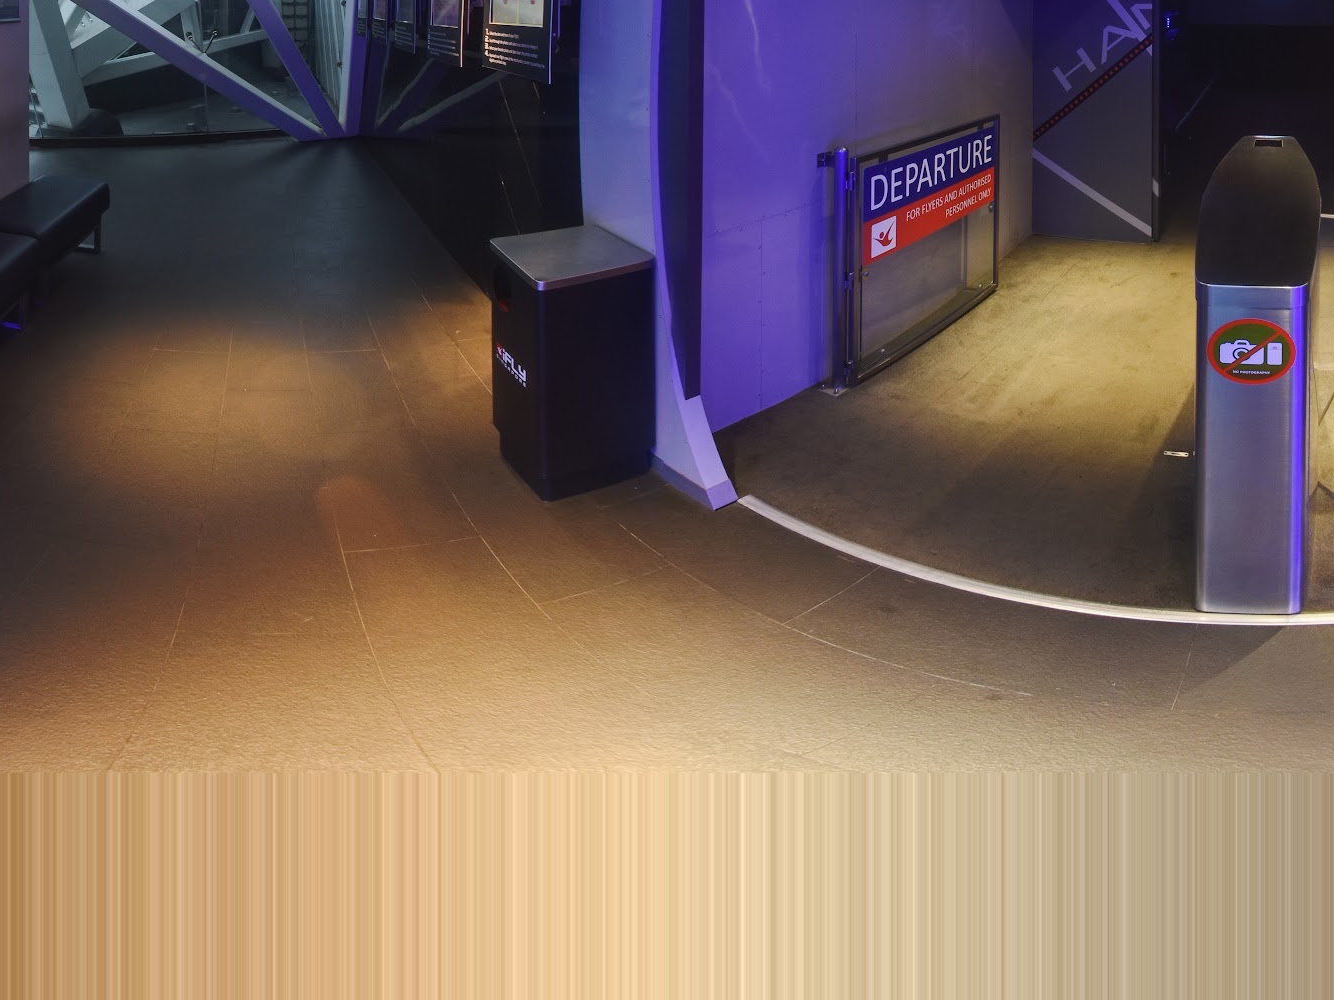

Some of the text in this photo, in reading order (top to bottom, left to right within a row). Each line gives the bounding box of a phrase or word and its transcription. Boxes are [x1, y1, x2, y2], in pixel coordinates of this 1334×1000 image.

[870, 134, 993, 211] DEPARTURE
[906, 173, 992, 222] FOR FLYERS AND AUTHORISED
[945, 187, 992, 218] PERSONNEL ONLY
[503, 348, 527, 382] iFLY
